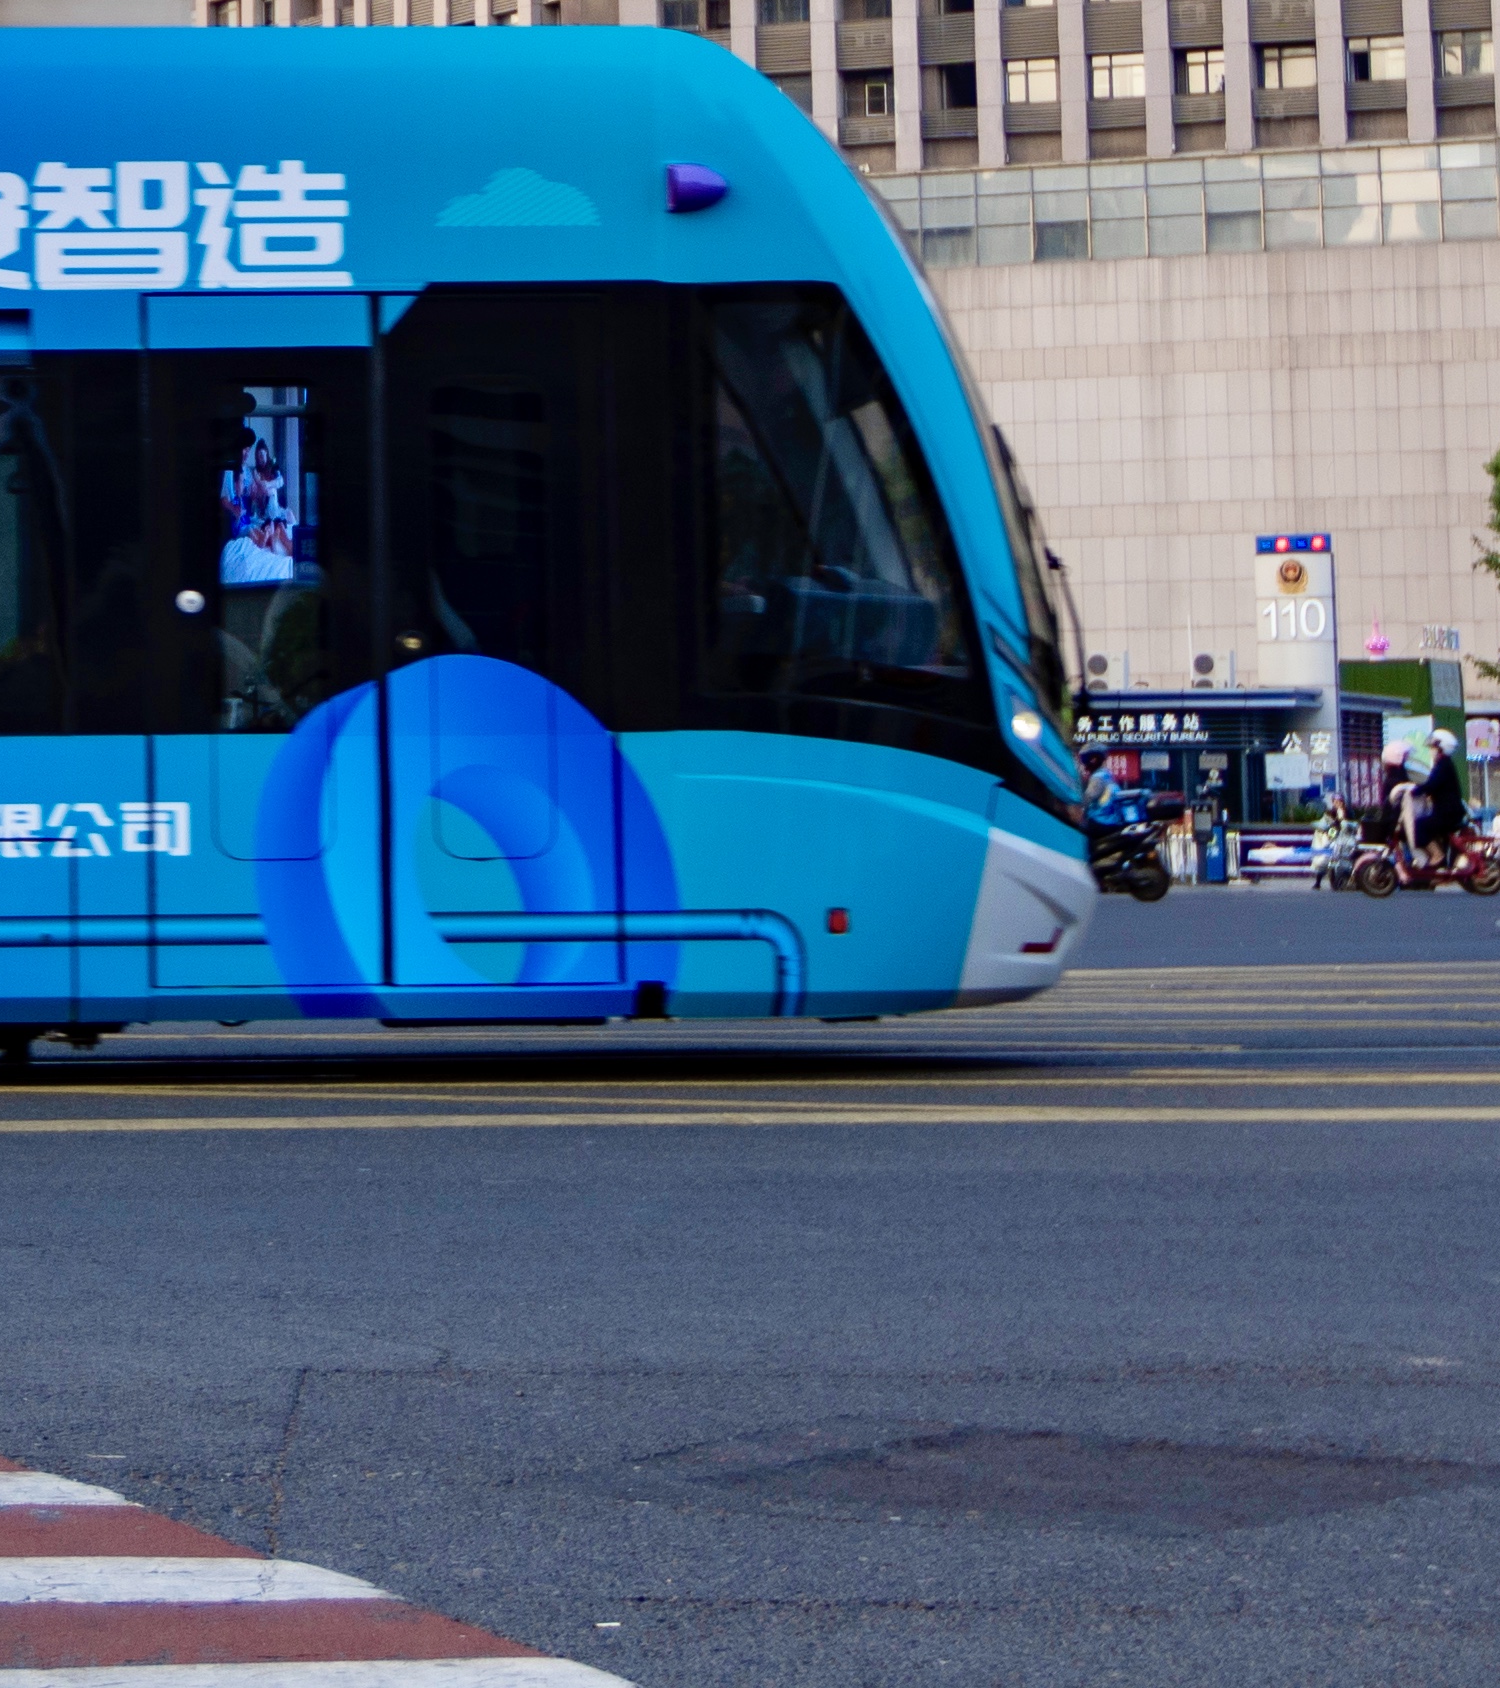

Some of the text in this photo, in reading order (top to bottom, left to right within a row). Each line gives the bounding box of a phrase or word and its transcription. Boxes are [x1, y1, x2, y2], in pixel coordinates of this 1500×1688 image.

[1261, 597, 1327, 642] 110
[1076, 712, 1201, 733] 务工作服务站
[1087, 732, 1120, 743] PUBLIC
[1122, 731, 1169, 743] SECURITY
[1170, 730, 1209, 743] BUREAU
[1280, 730, 1332, 756] 公安
